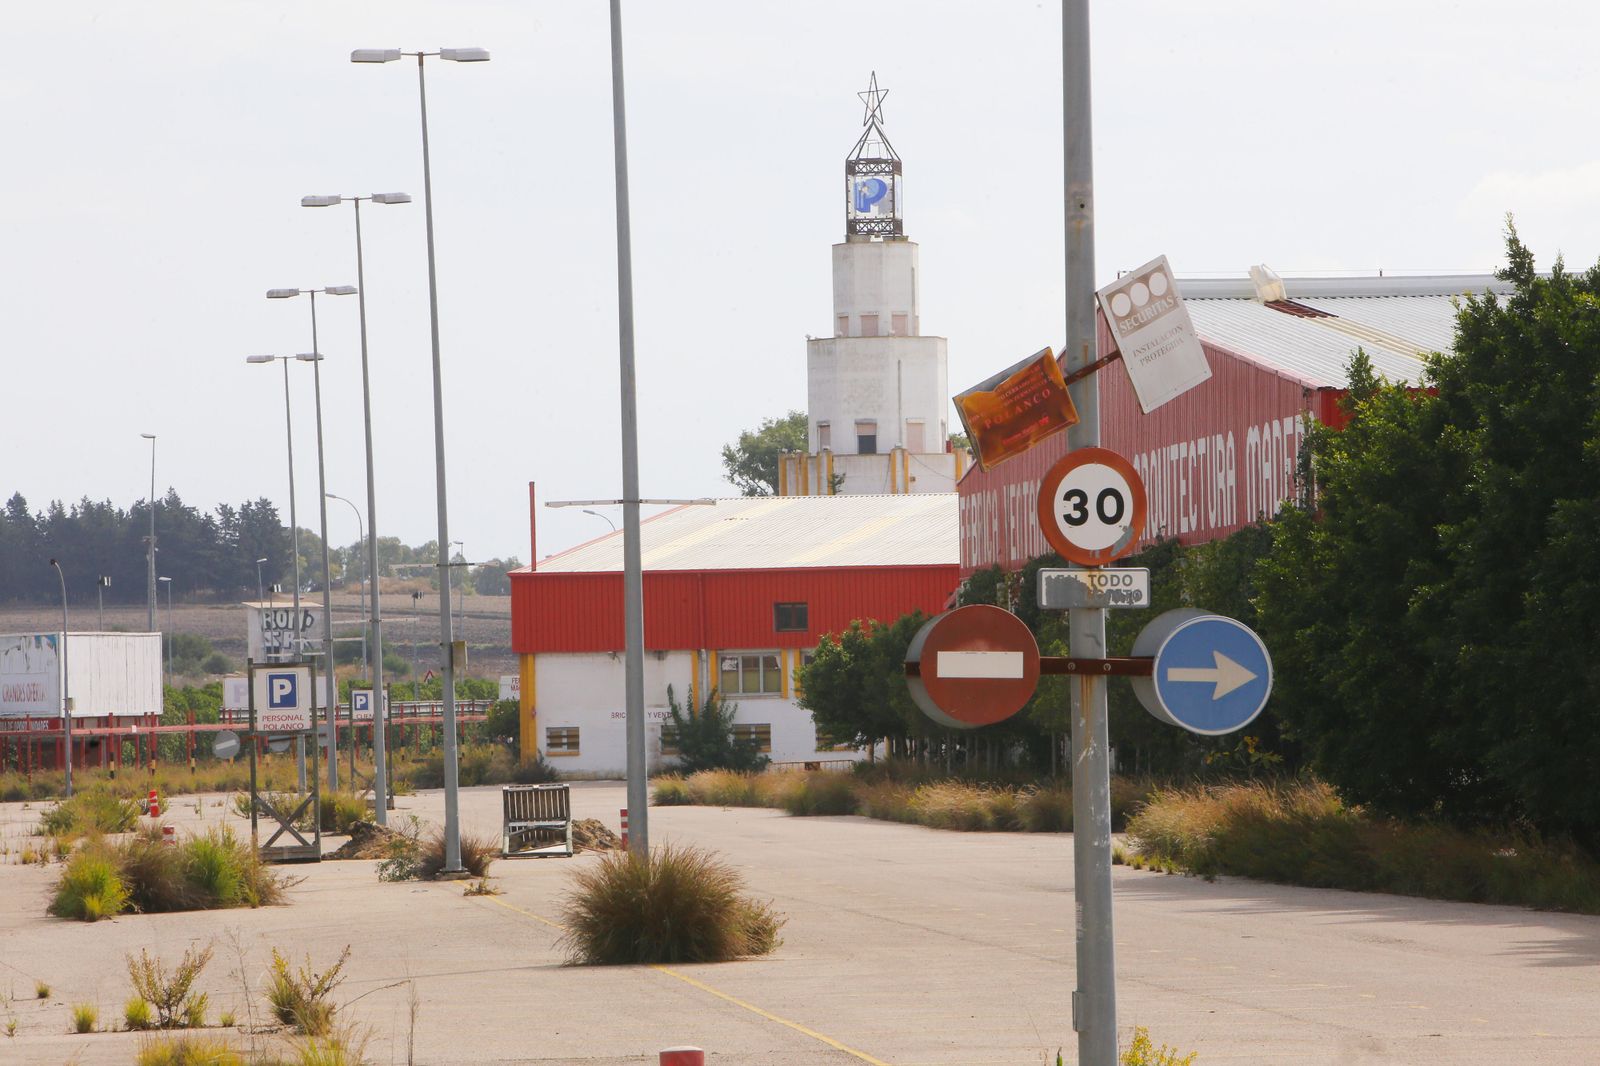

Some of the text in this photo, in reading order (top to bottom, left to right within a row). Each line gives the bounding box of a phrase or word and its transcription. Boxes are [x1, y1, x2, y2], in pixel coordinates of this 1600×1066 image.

[1119, 295, 1175, 333] SECURITAS
[984, 388, 1051, 430] POLANCO
[1062, 487, 1125, 527] 30
[1087, 574, 1133, 587] TODO
[272, 678, 292, 704] P
[356, 695, 367, 709] P
[263, 723, 304, 731] POLANCO
